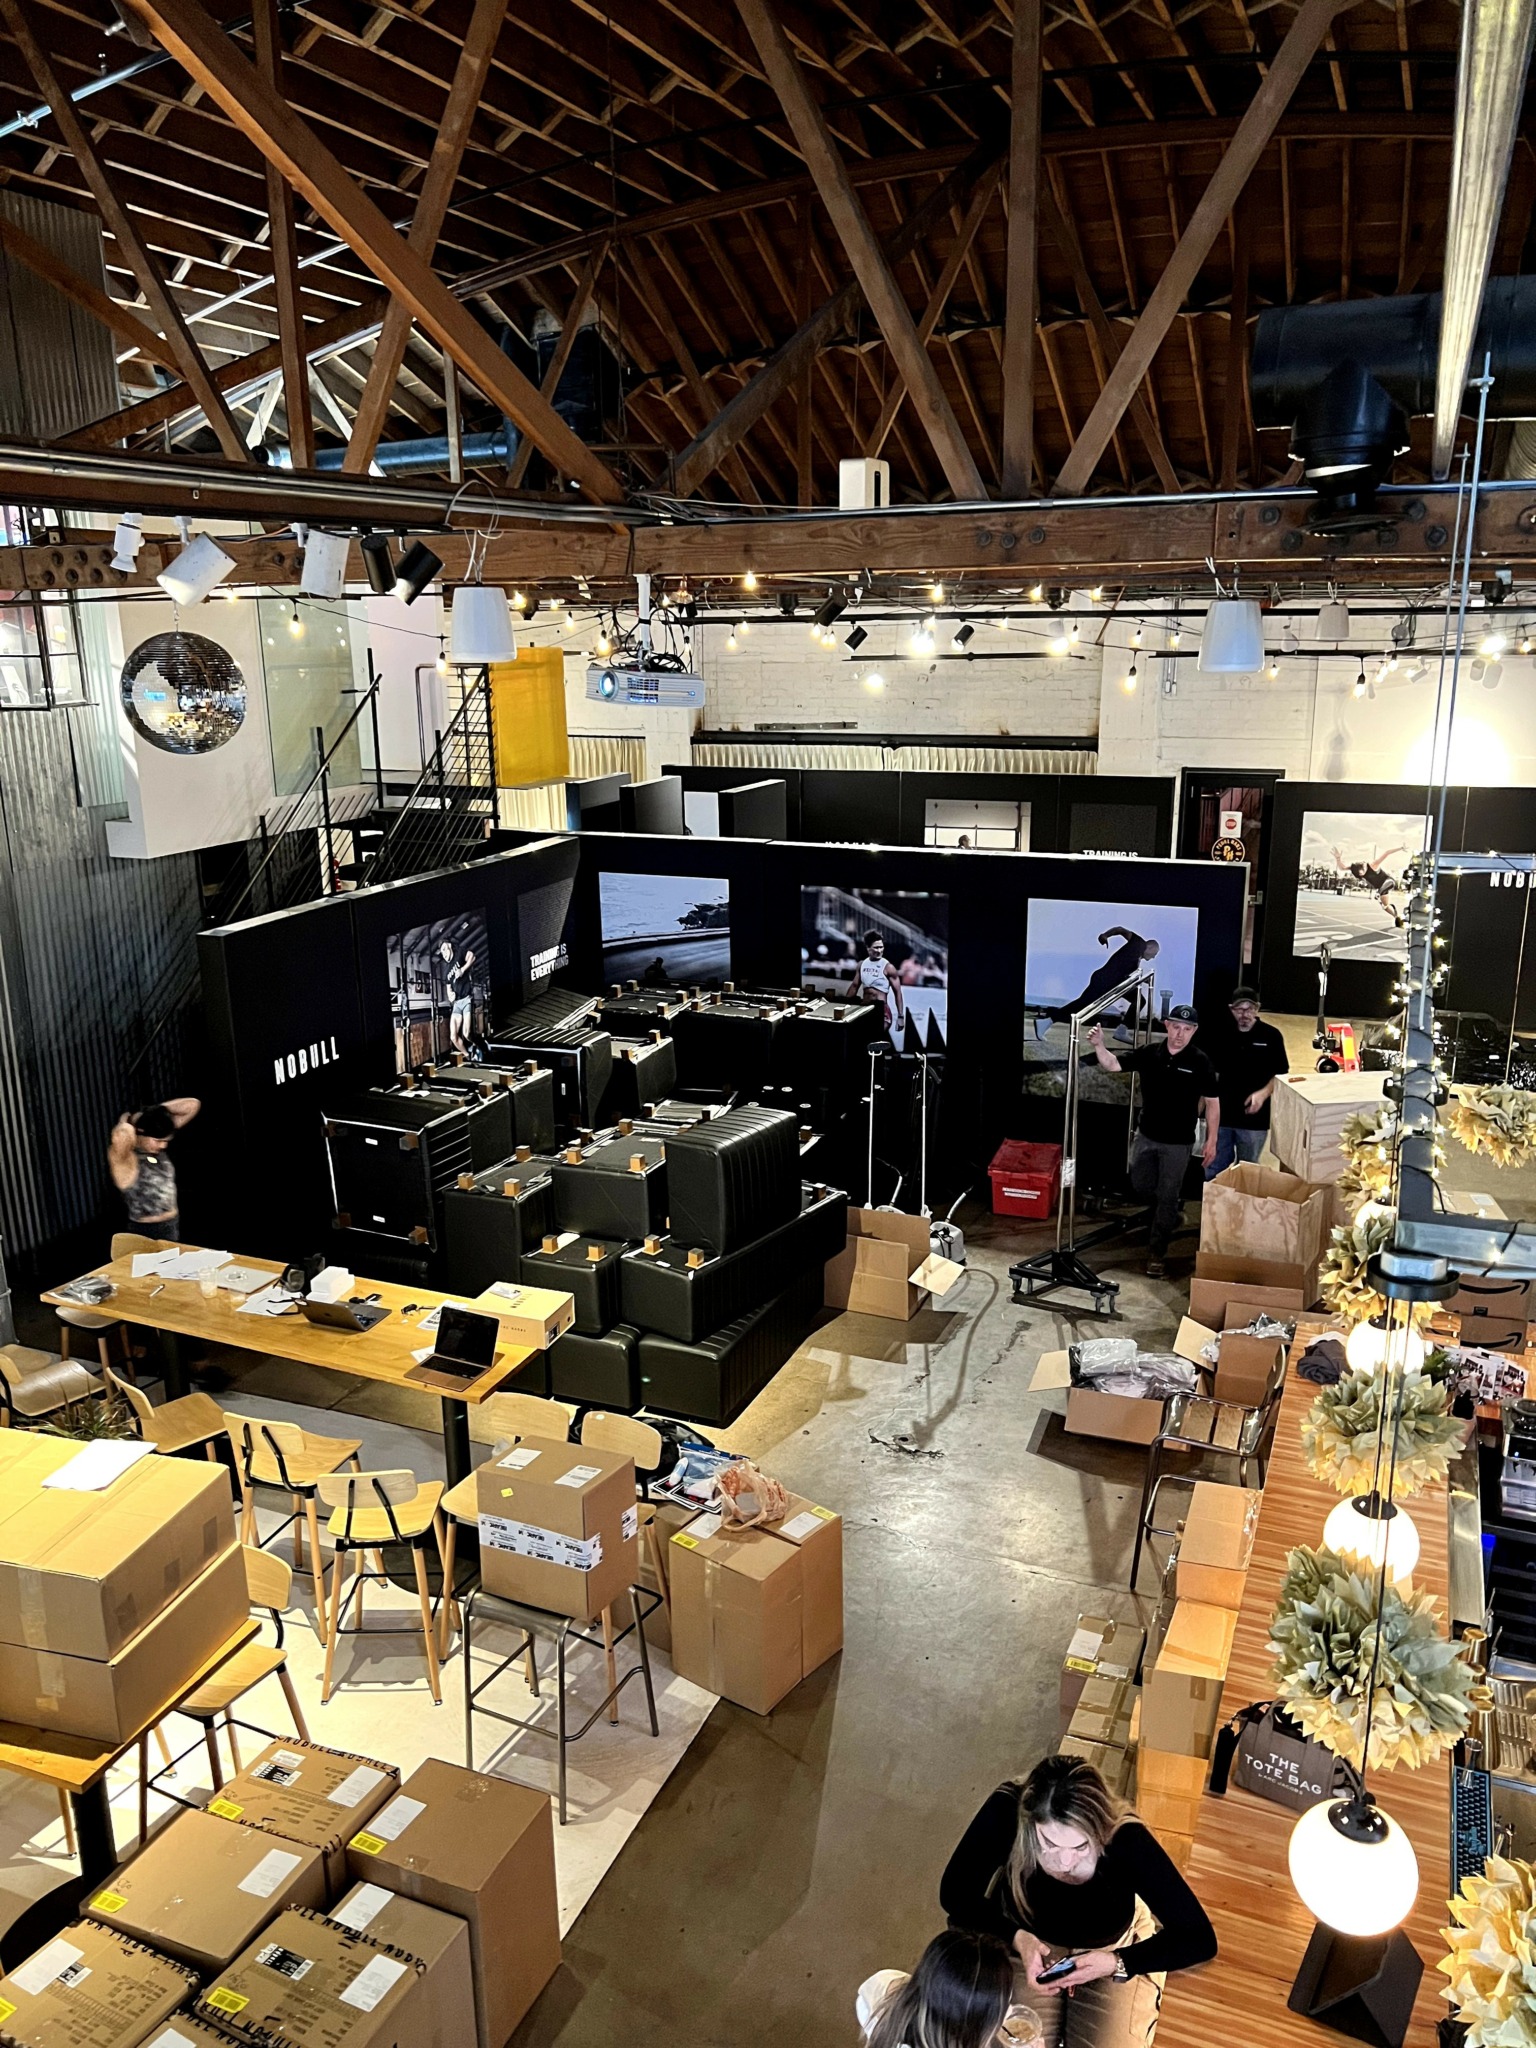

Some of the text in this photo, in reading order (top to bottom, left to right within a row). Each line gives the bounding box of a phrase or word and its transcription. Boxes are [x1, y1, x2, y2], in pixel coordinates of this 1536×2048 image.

[530, 943, 567, 968] TRAINING IS
[531, 955, 568, 981] EVERYTHING
[274, 1036, 340, 1085] NOBULL
[1245, 1753, 1322, 1795] TOTE BAG
[1269, 1753, 1300, 1774] THE
